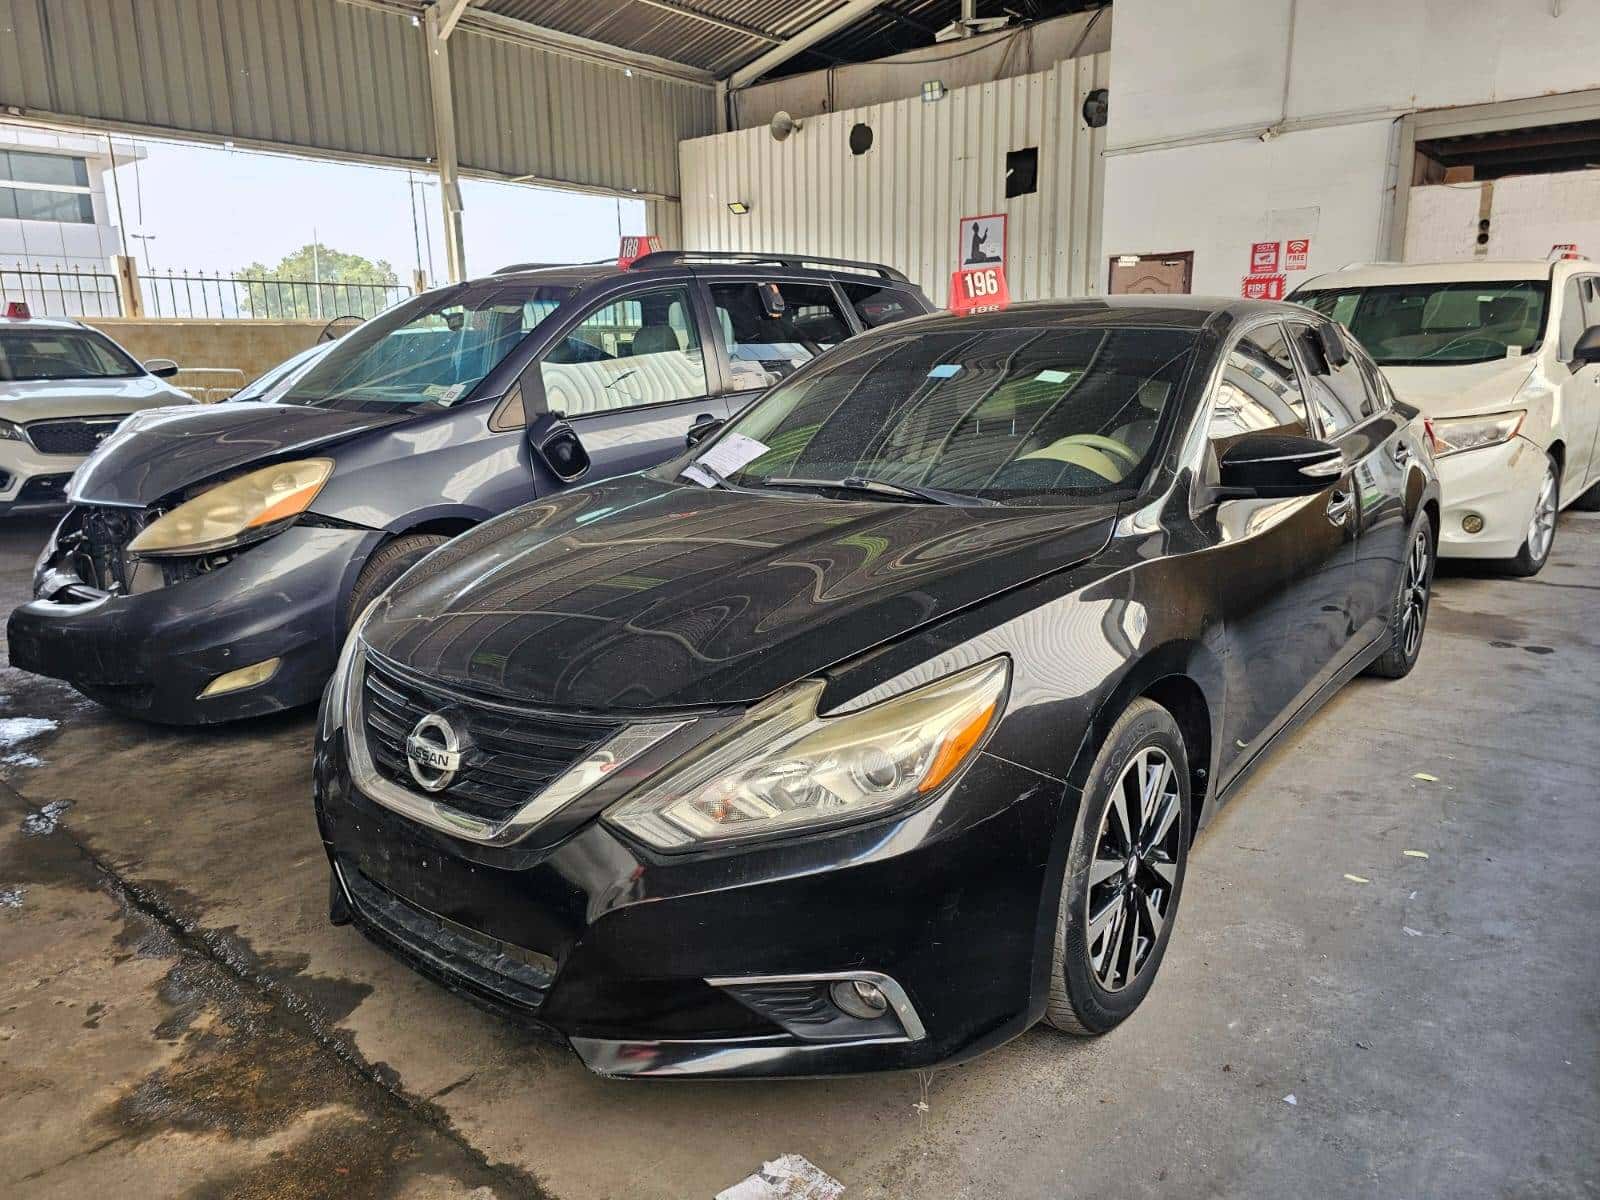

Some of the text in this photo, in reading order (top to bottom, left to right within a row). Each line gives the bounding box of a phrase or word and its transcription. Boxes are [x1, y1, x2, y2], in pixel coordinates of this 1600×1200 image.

[623, 238, 638, 258] 188
[1288, 254, 1305, 262] FREE
[965, 270, 998, 298] 196
[1247, 283, 1266, 294] FIRE
[407, 739, 450, 767] NISSAN
